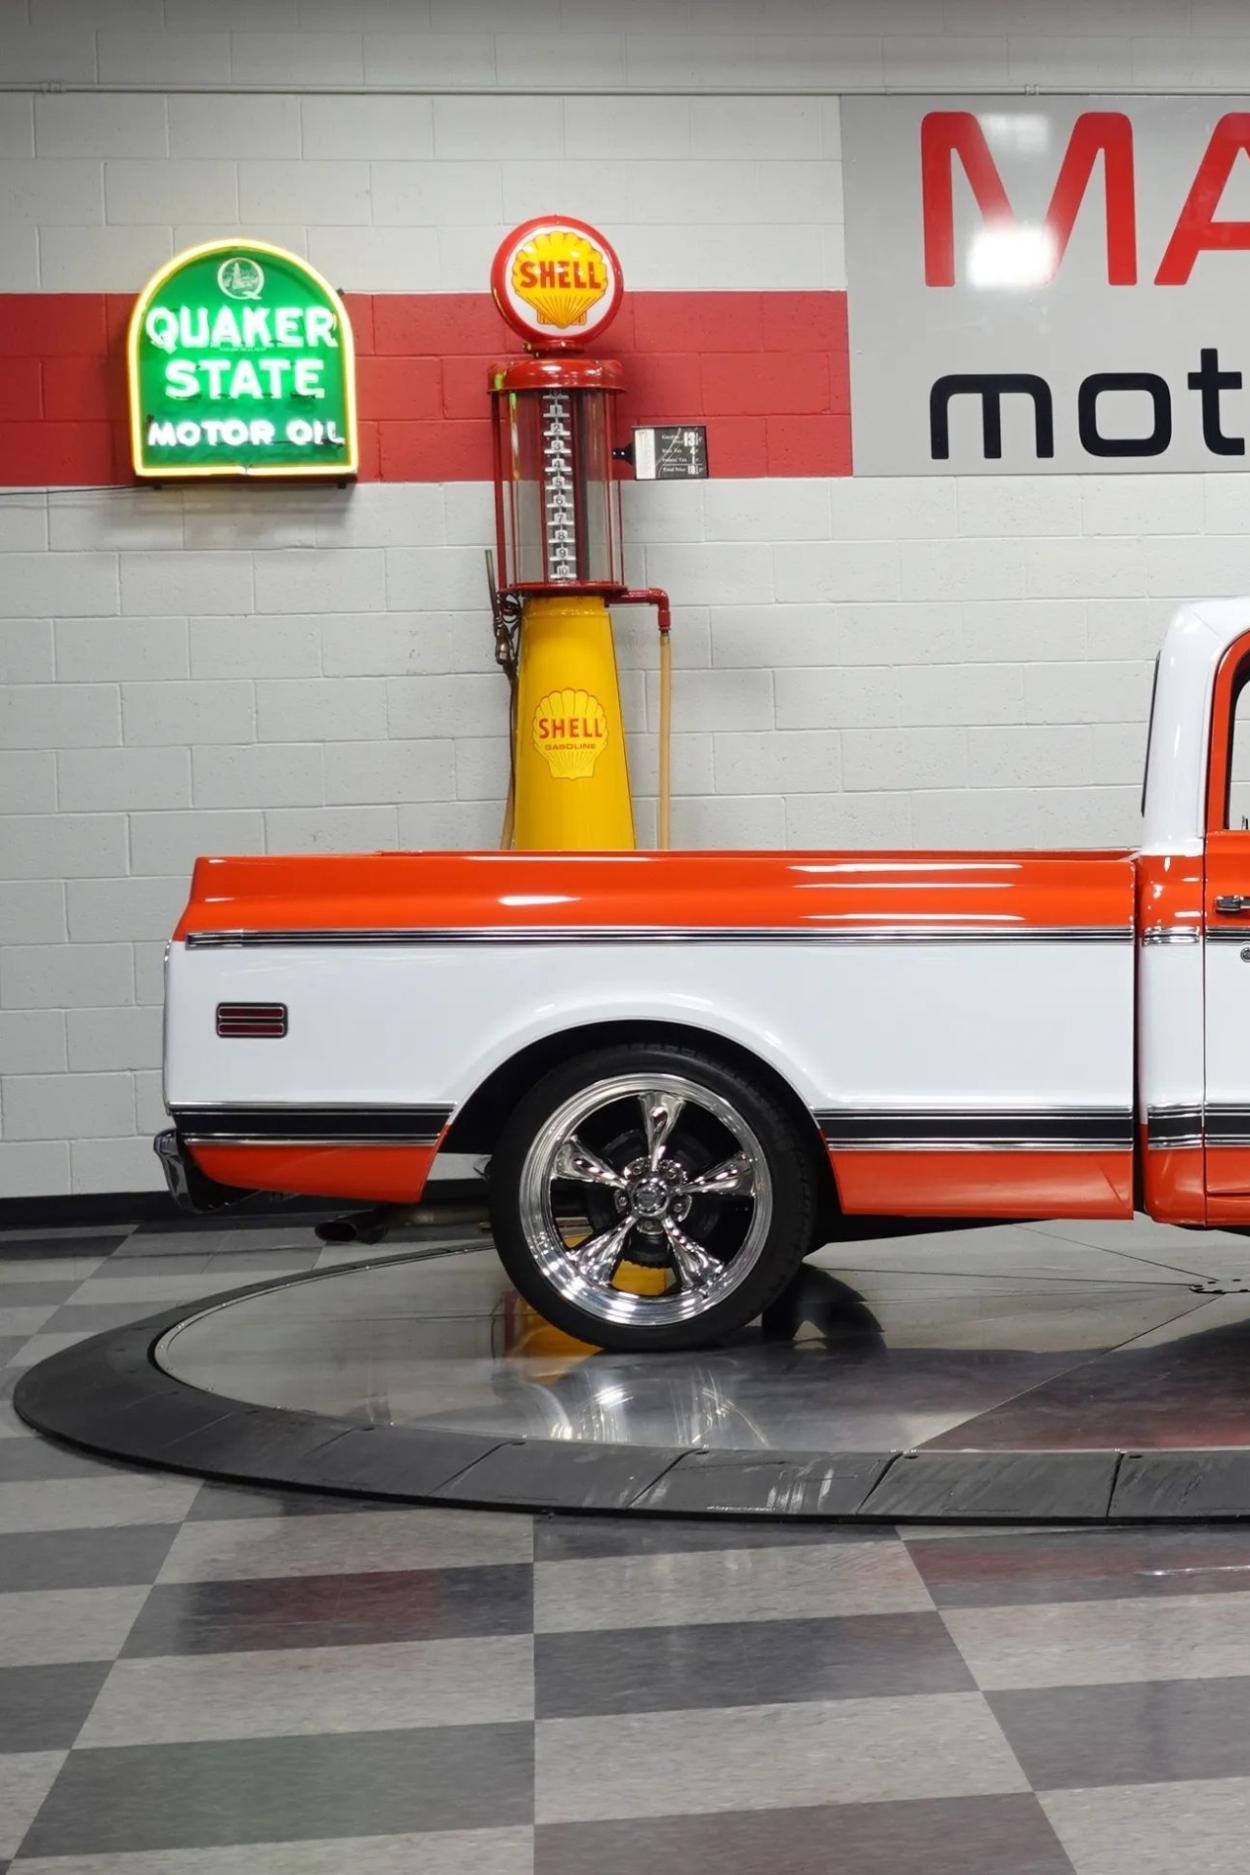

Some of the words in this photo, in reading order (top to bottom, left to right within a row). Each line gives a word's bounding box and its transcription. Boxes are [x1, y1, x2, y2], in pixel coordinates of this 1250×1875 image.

[519, 260, 602, 289] SHELL
[146, 305, 339, 354] QUAKER
[165, 359, 325, 400] STATE
[148, 419, 276, 446] MOTOR
[286, 419, 345, 446] OIL
[538, 717, 602, 739] SHELL
[545, 743, 596, 751] GASOLINE
